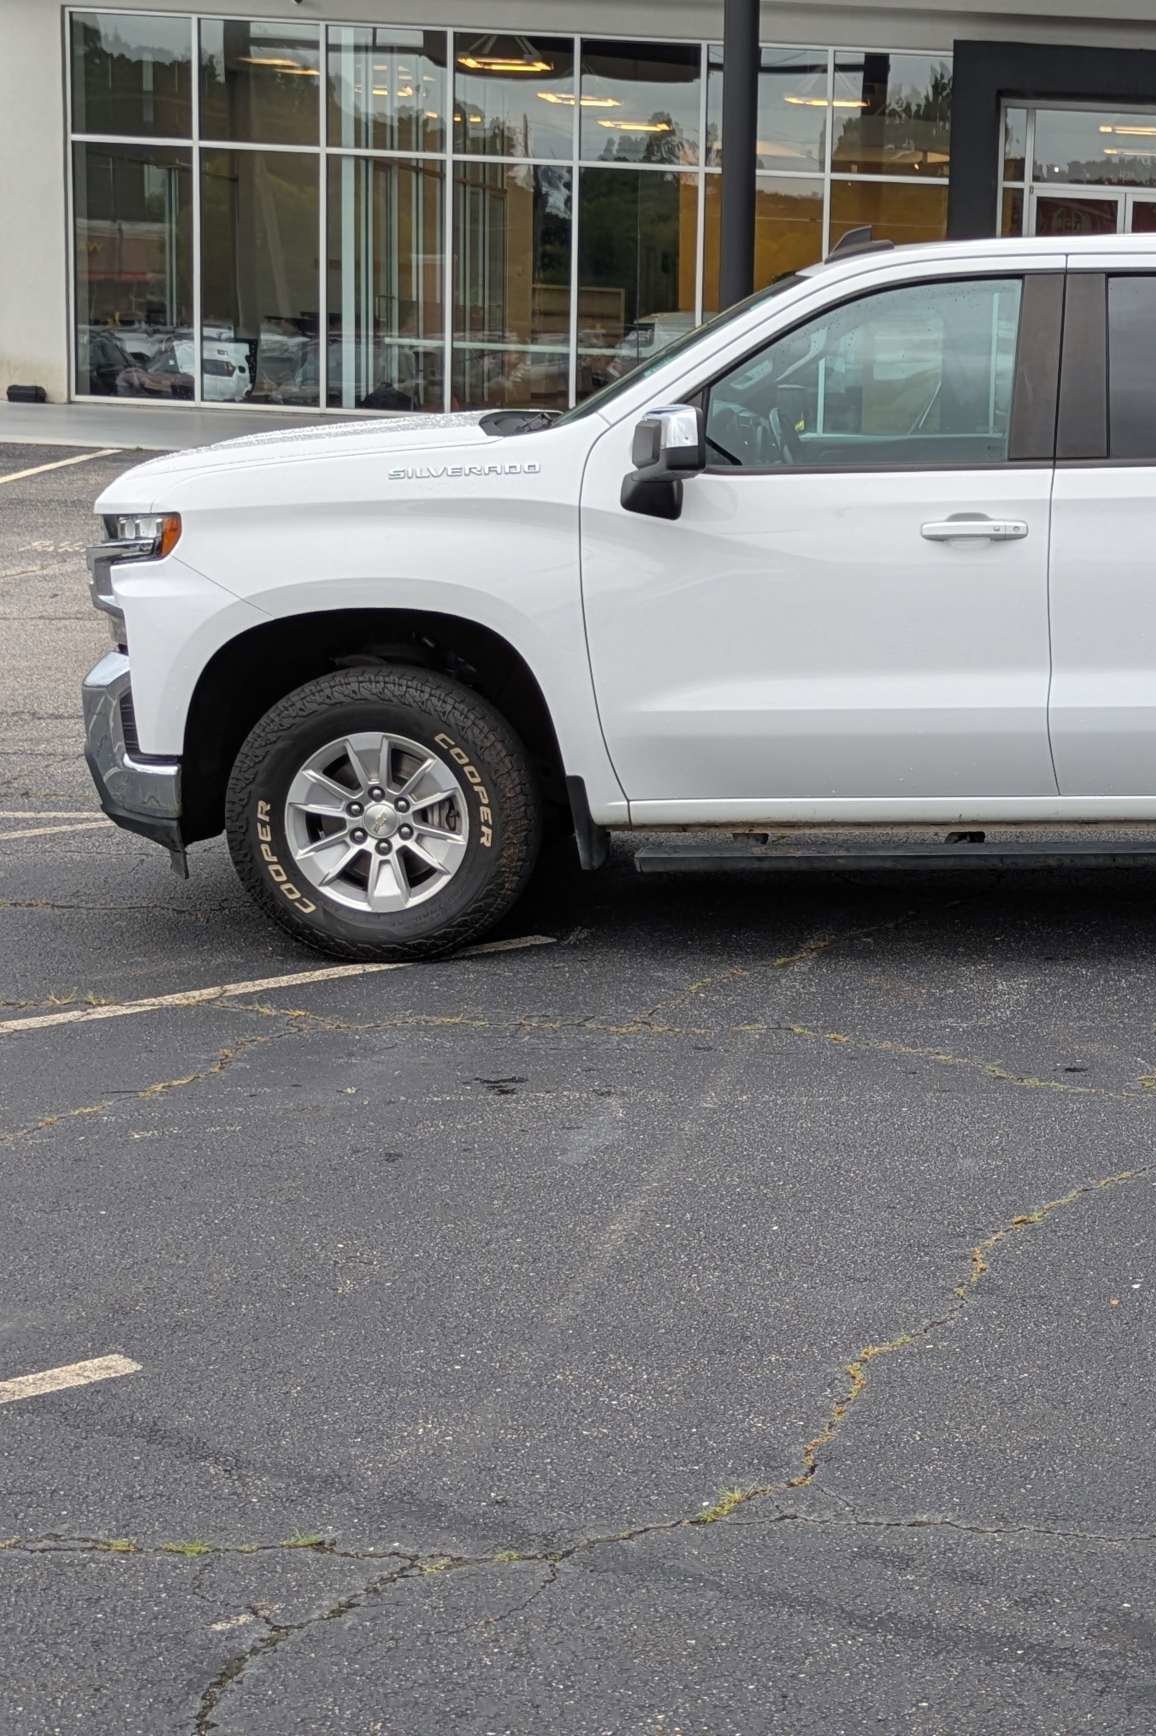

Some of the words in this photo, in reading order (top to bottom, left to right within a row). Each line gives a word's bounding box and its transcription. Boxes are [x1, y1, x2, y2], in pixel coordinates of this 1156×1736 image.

[388, 461, 542, 480] SILVERADO
[434, 732, 493, 848] COOPER
[255, 800, 316, 914] COOPER
